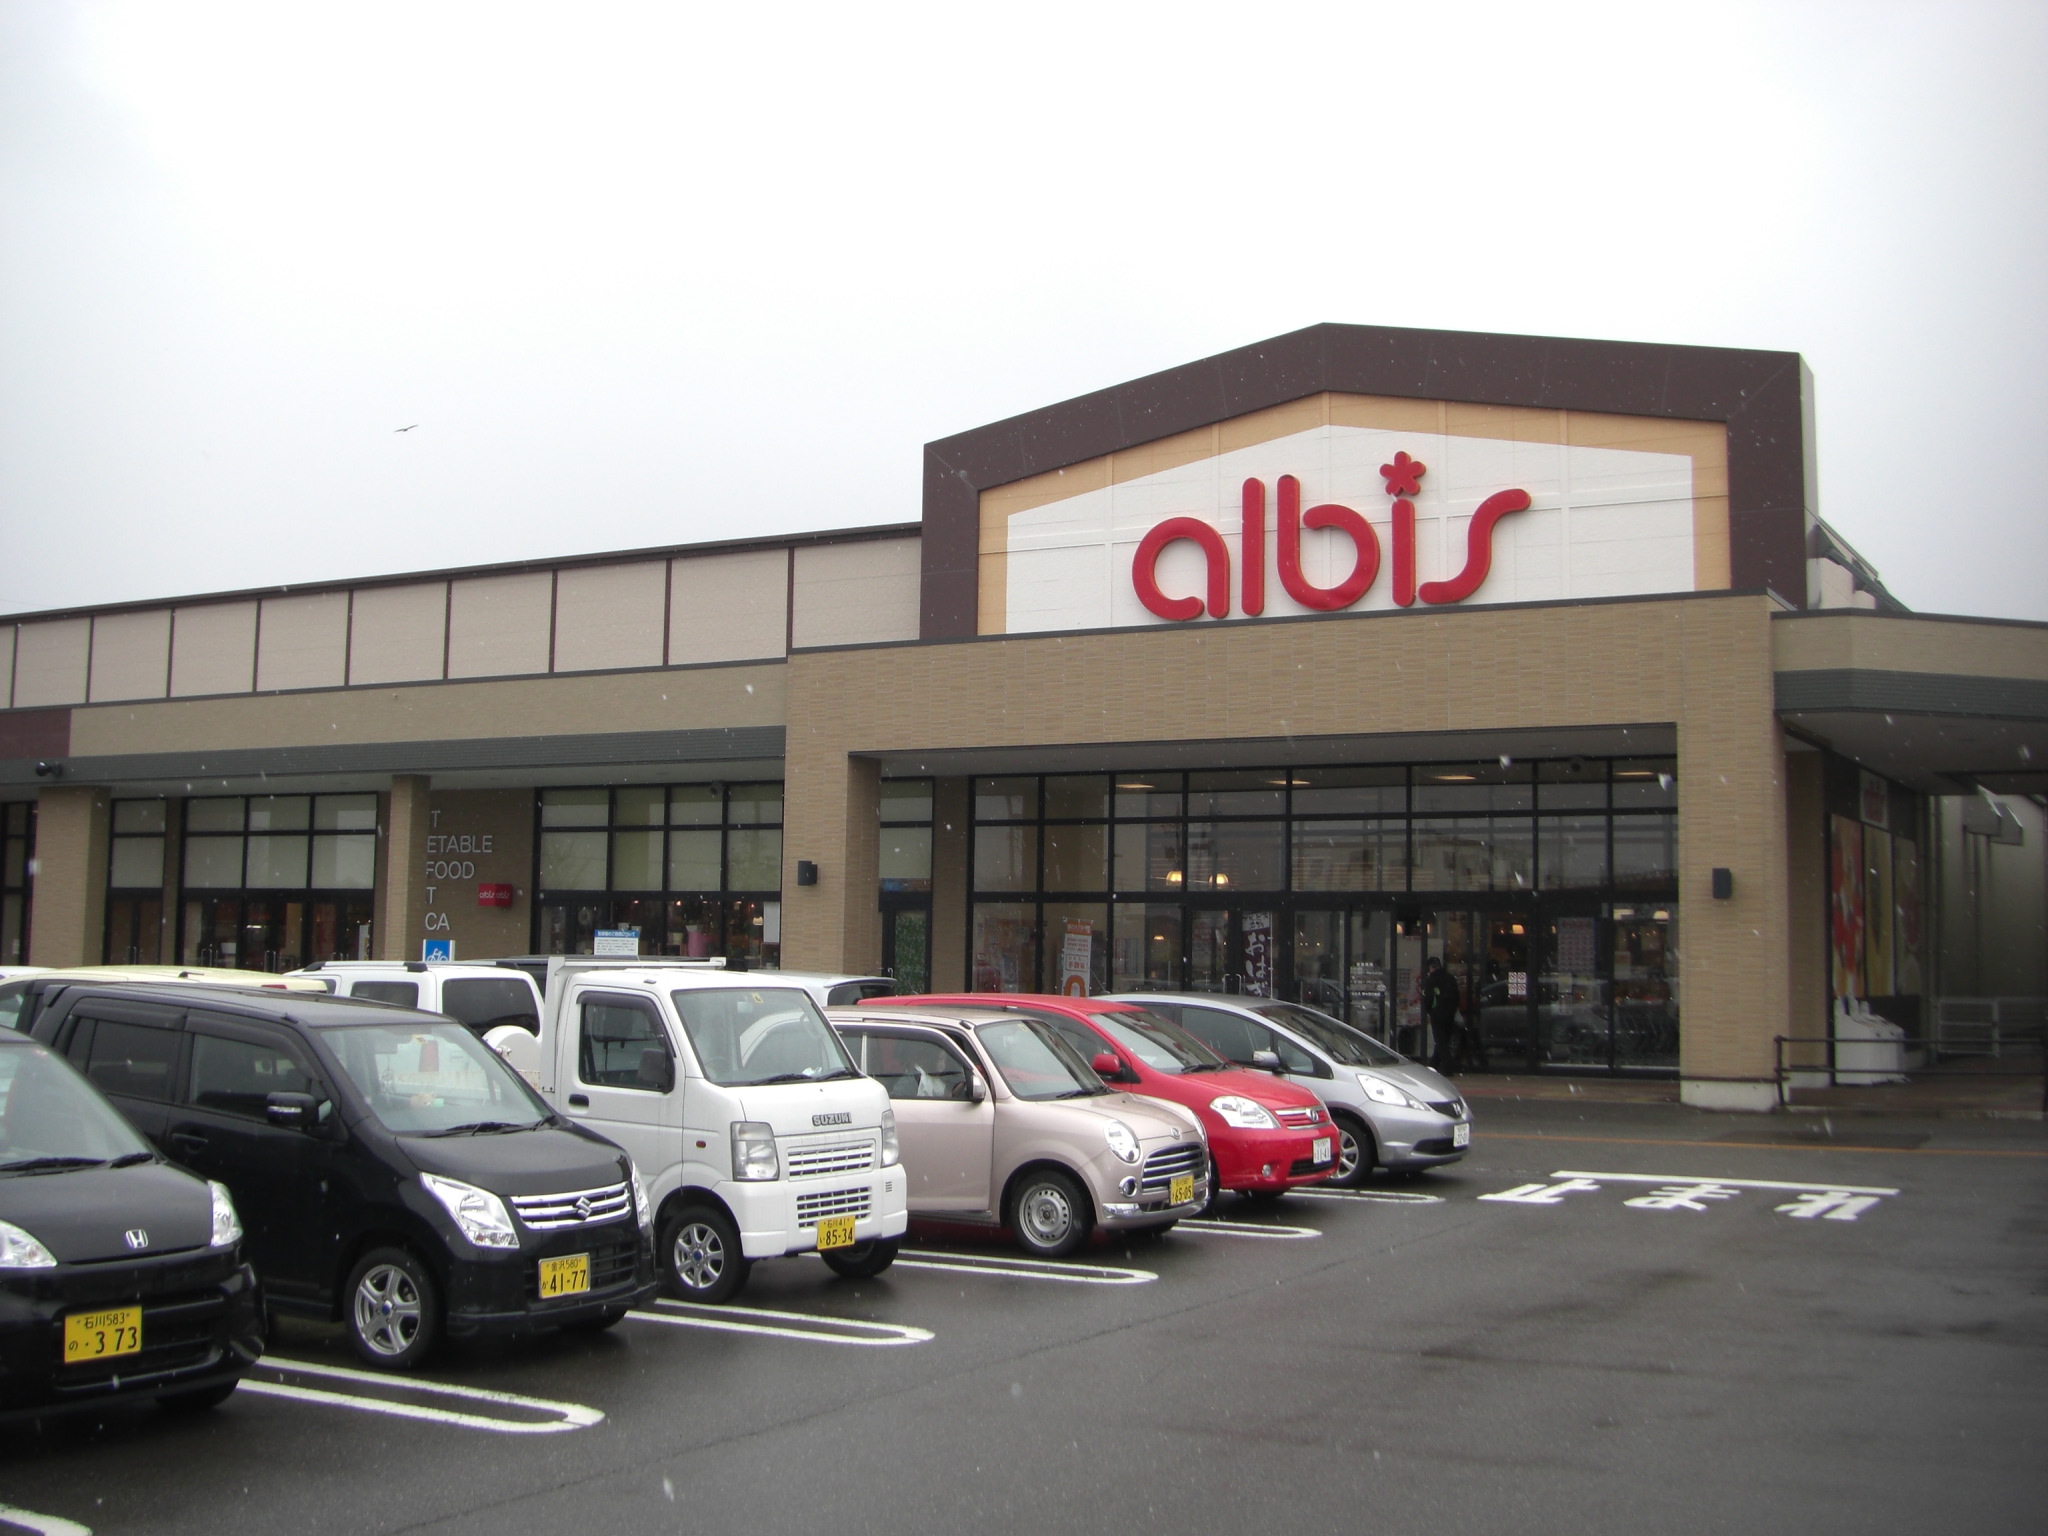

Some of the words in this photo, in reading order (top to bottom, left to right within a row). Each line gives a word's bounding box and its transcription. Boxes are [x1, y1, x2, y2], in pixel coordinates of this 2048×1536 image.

[1132, 450, 1531, 621] albis
[427, 835, 493, 853] ETABLE
[426, 861, 475, 879] FOOD
[425, 912, 450, 931] CA
[812, 1112, 852, 1127] SUZUKI
[826, 1227, 853, 1246] 85-34
[549, 1269, 587, 1293] 41-77
[84, 1312, 126, 1330] 石川583
